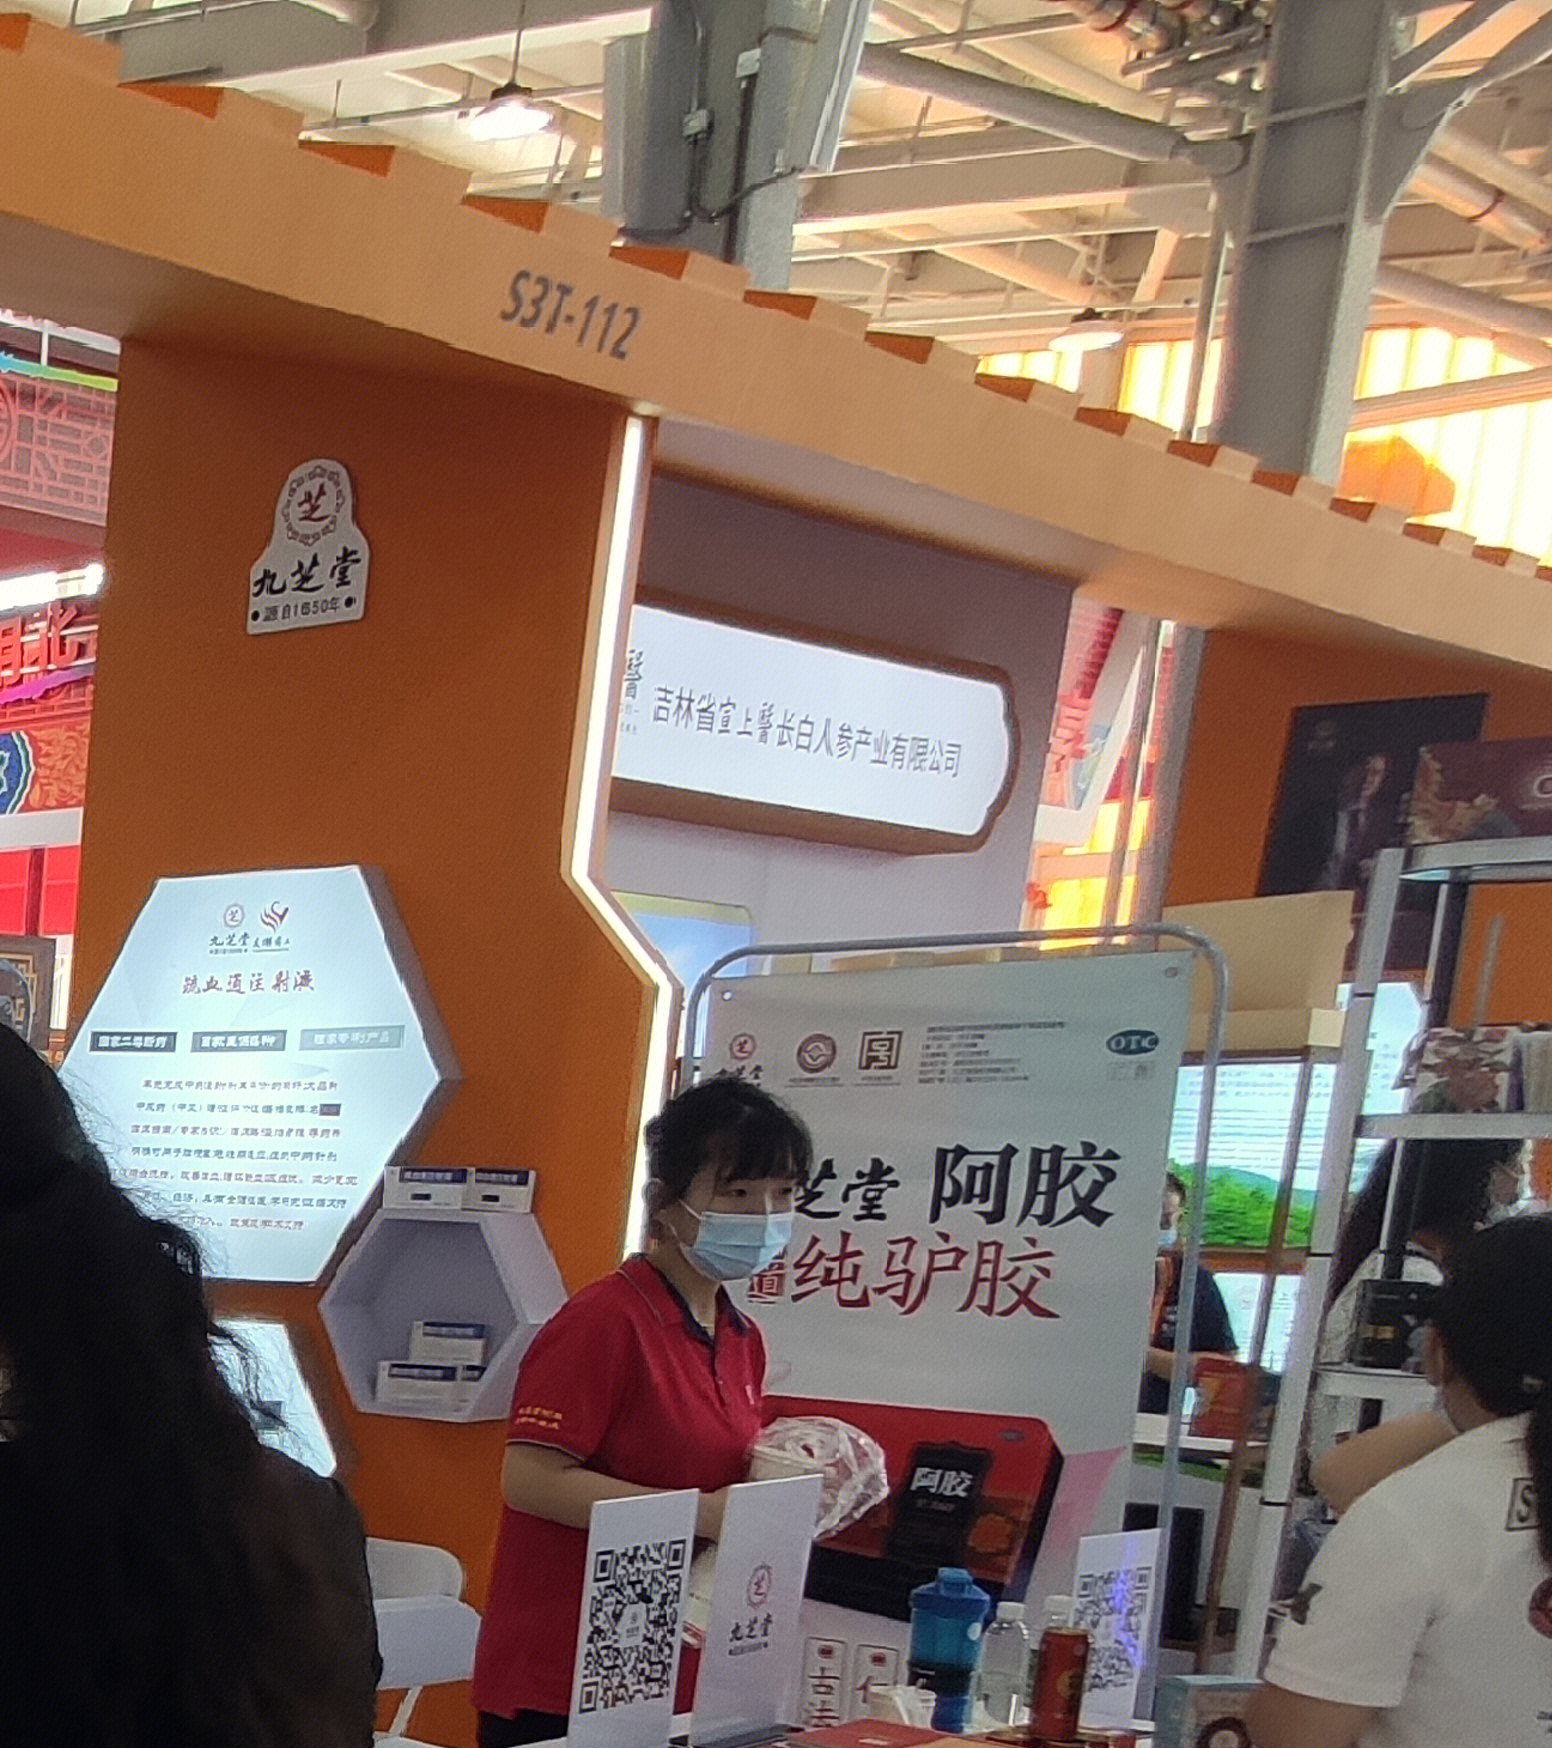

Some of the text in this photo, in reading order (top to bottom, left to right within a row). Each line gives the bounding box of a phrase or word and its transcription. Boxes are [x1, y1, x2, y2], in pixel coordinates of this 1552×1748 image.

[499, 269, 640, 361] S3T-112
[298, 482, 331, 522] 芝
[252, 546, 361, 598] 九芝堂
[263, 597, 340, 622] 源自1650年
[1109, 1034, 1158, 1052] OTC
[928, 1141, 1123, 1228] 阿胶
[790, 1229, 1061, 1319] 纯驴胶
[909, 1466, 974, 1498] 阿胶
